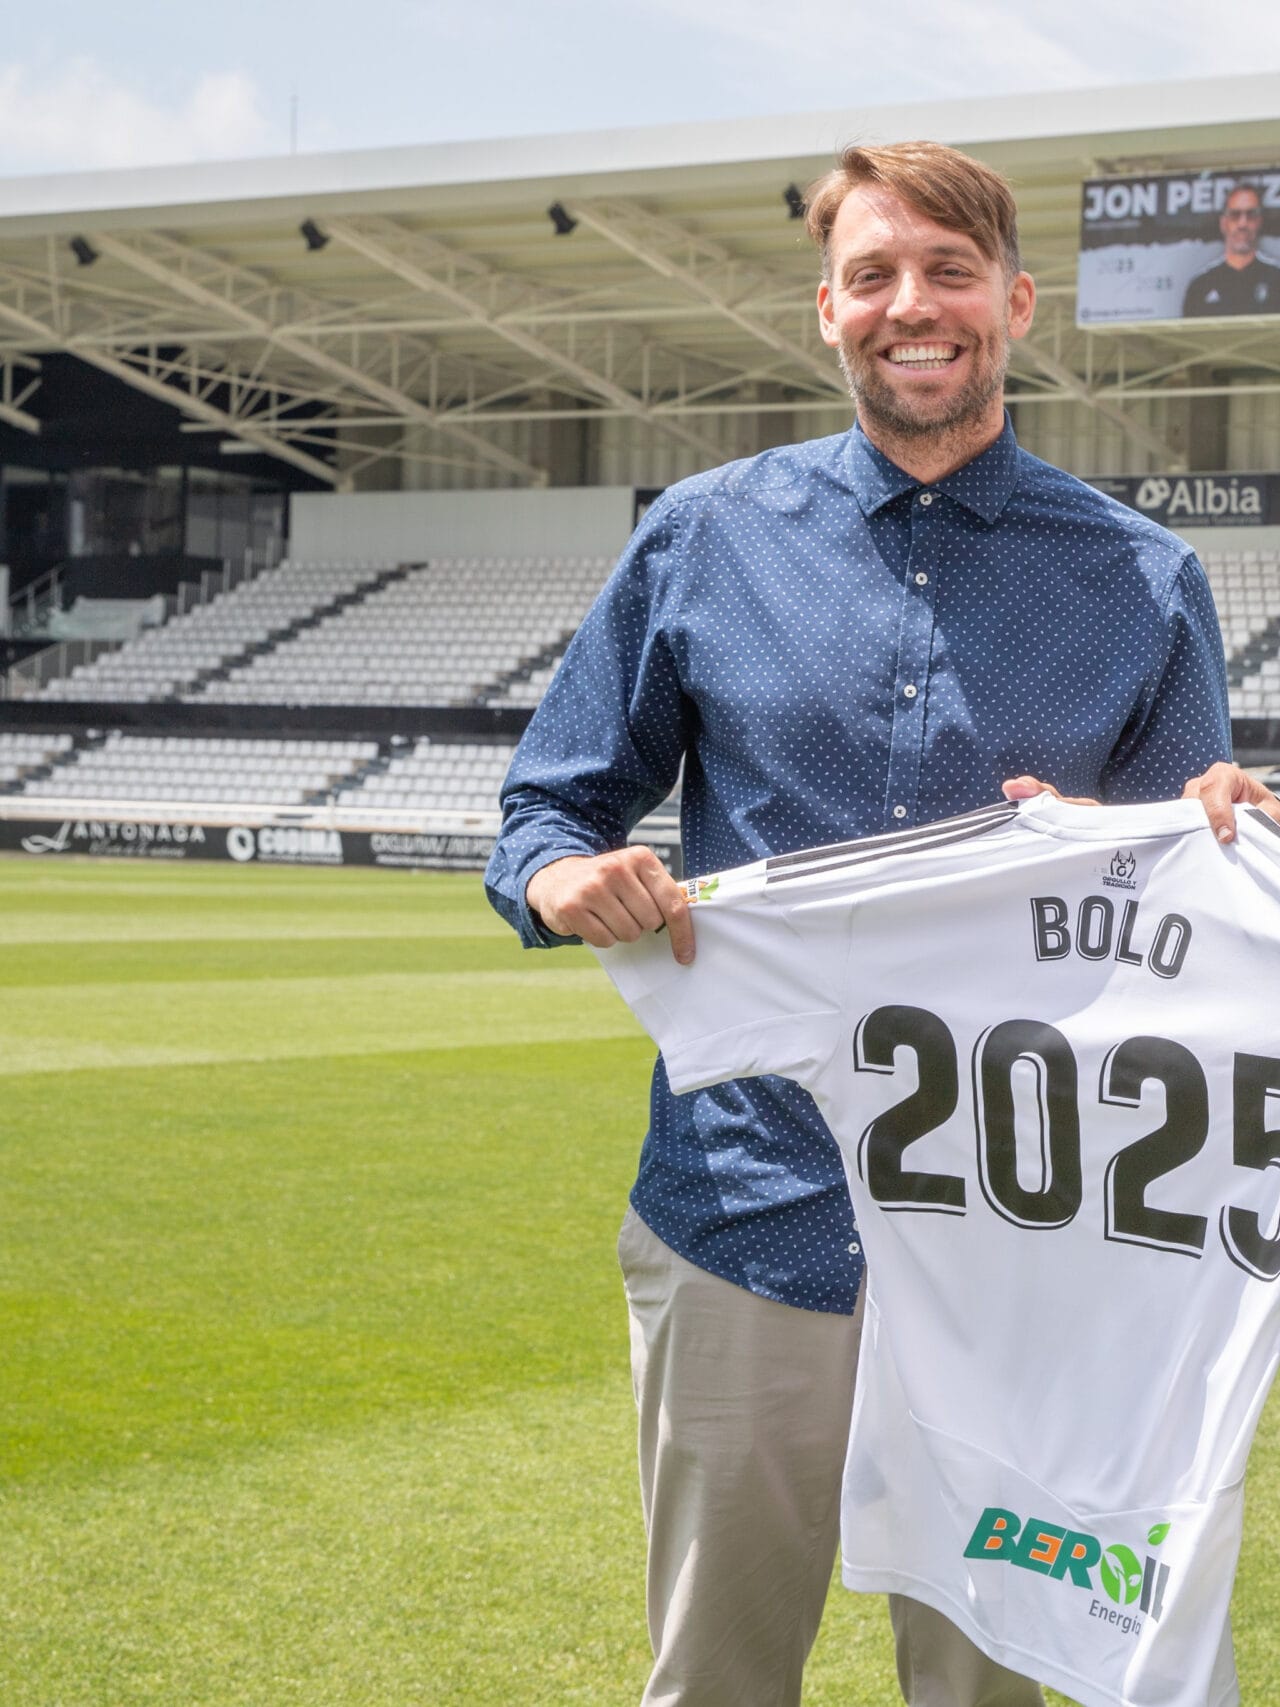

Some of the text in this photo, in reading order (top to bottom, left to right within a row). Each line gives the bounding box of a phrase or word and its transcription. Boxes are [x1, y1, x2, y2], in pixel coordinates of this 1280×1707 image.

[1084, 183, 1158, 220] JON
[1166, 478, 1262, 515] Albia
[1030, 895, 1192, 979] BOLO
